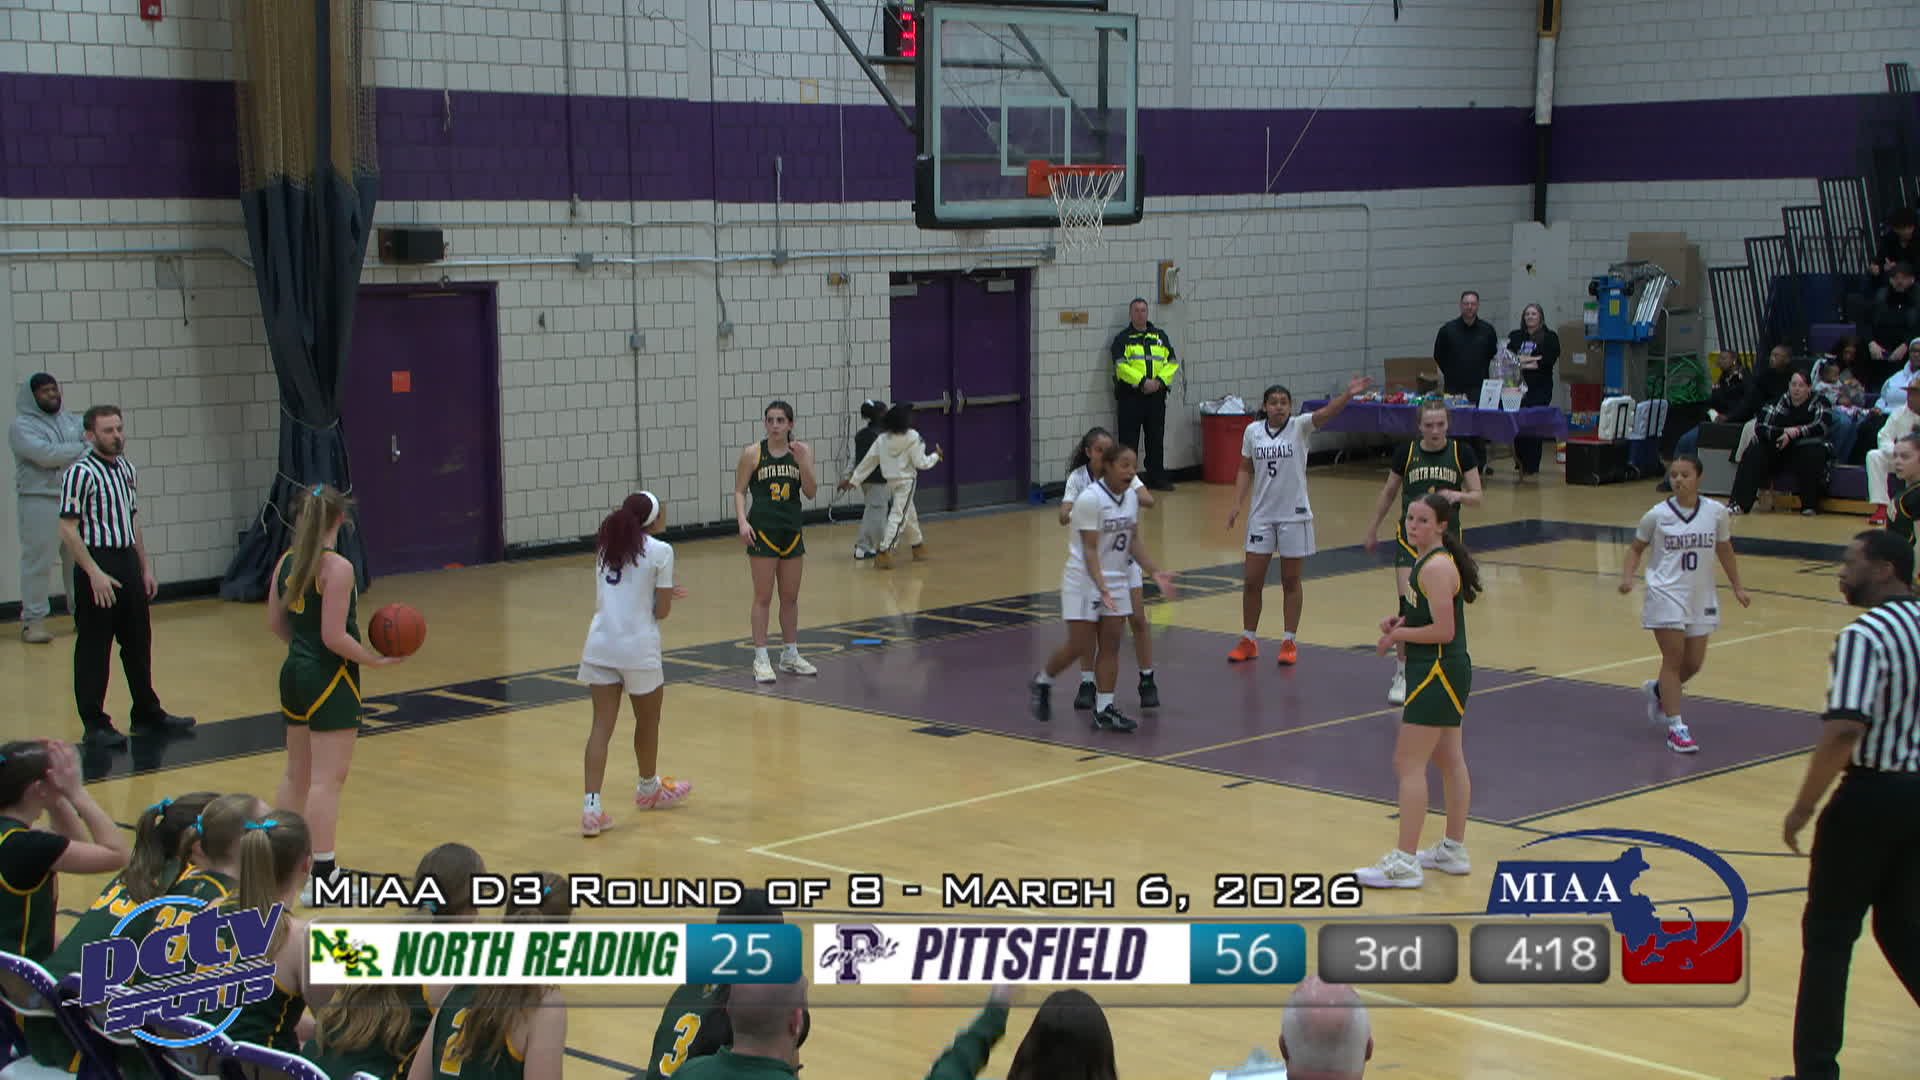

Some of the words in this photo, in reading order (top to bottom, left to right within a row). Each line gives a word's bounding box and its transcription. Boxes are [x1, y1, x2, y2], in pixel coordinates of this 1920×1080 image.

[1267, 461, 1277, 478] 5
[769, 482, 790, 501] 24
[1112, 532, 1127, 552] 13
[1664, 532, 1714, 550] GENERALS
[1681, 551, 1698, 571] 10
